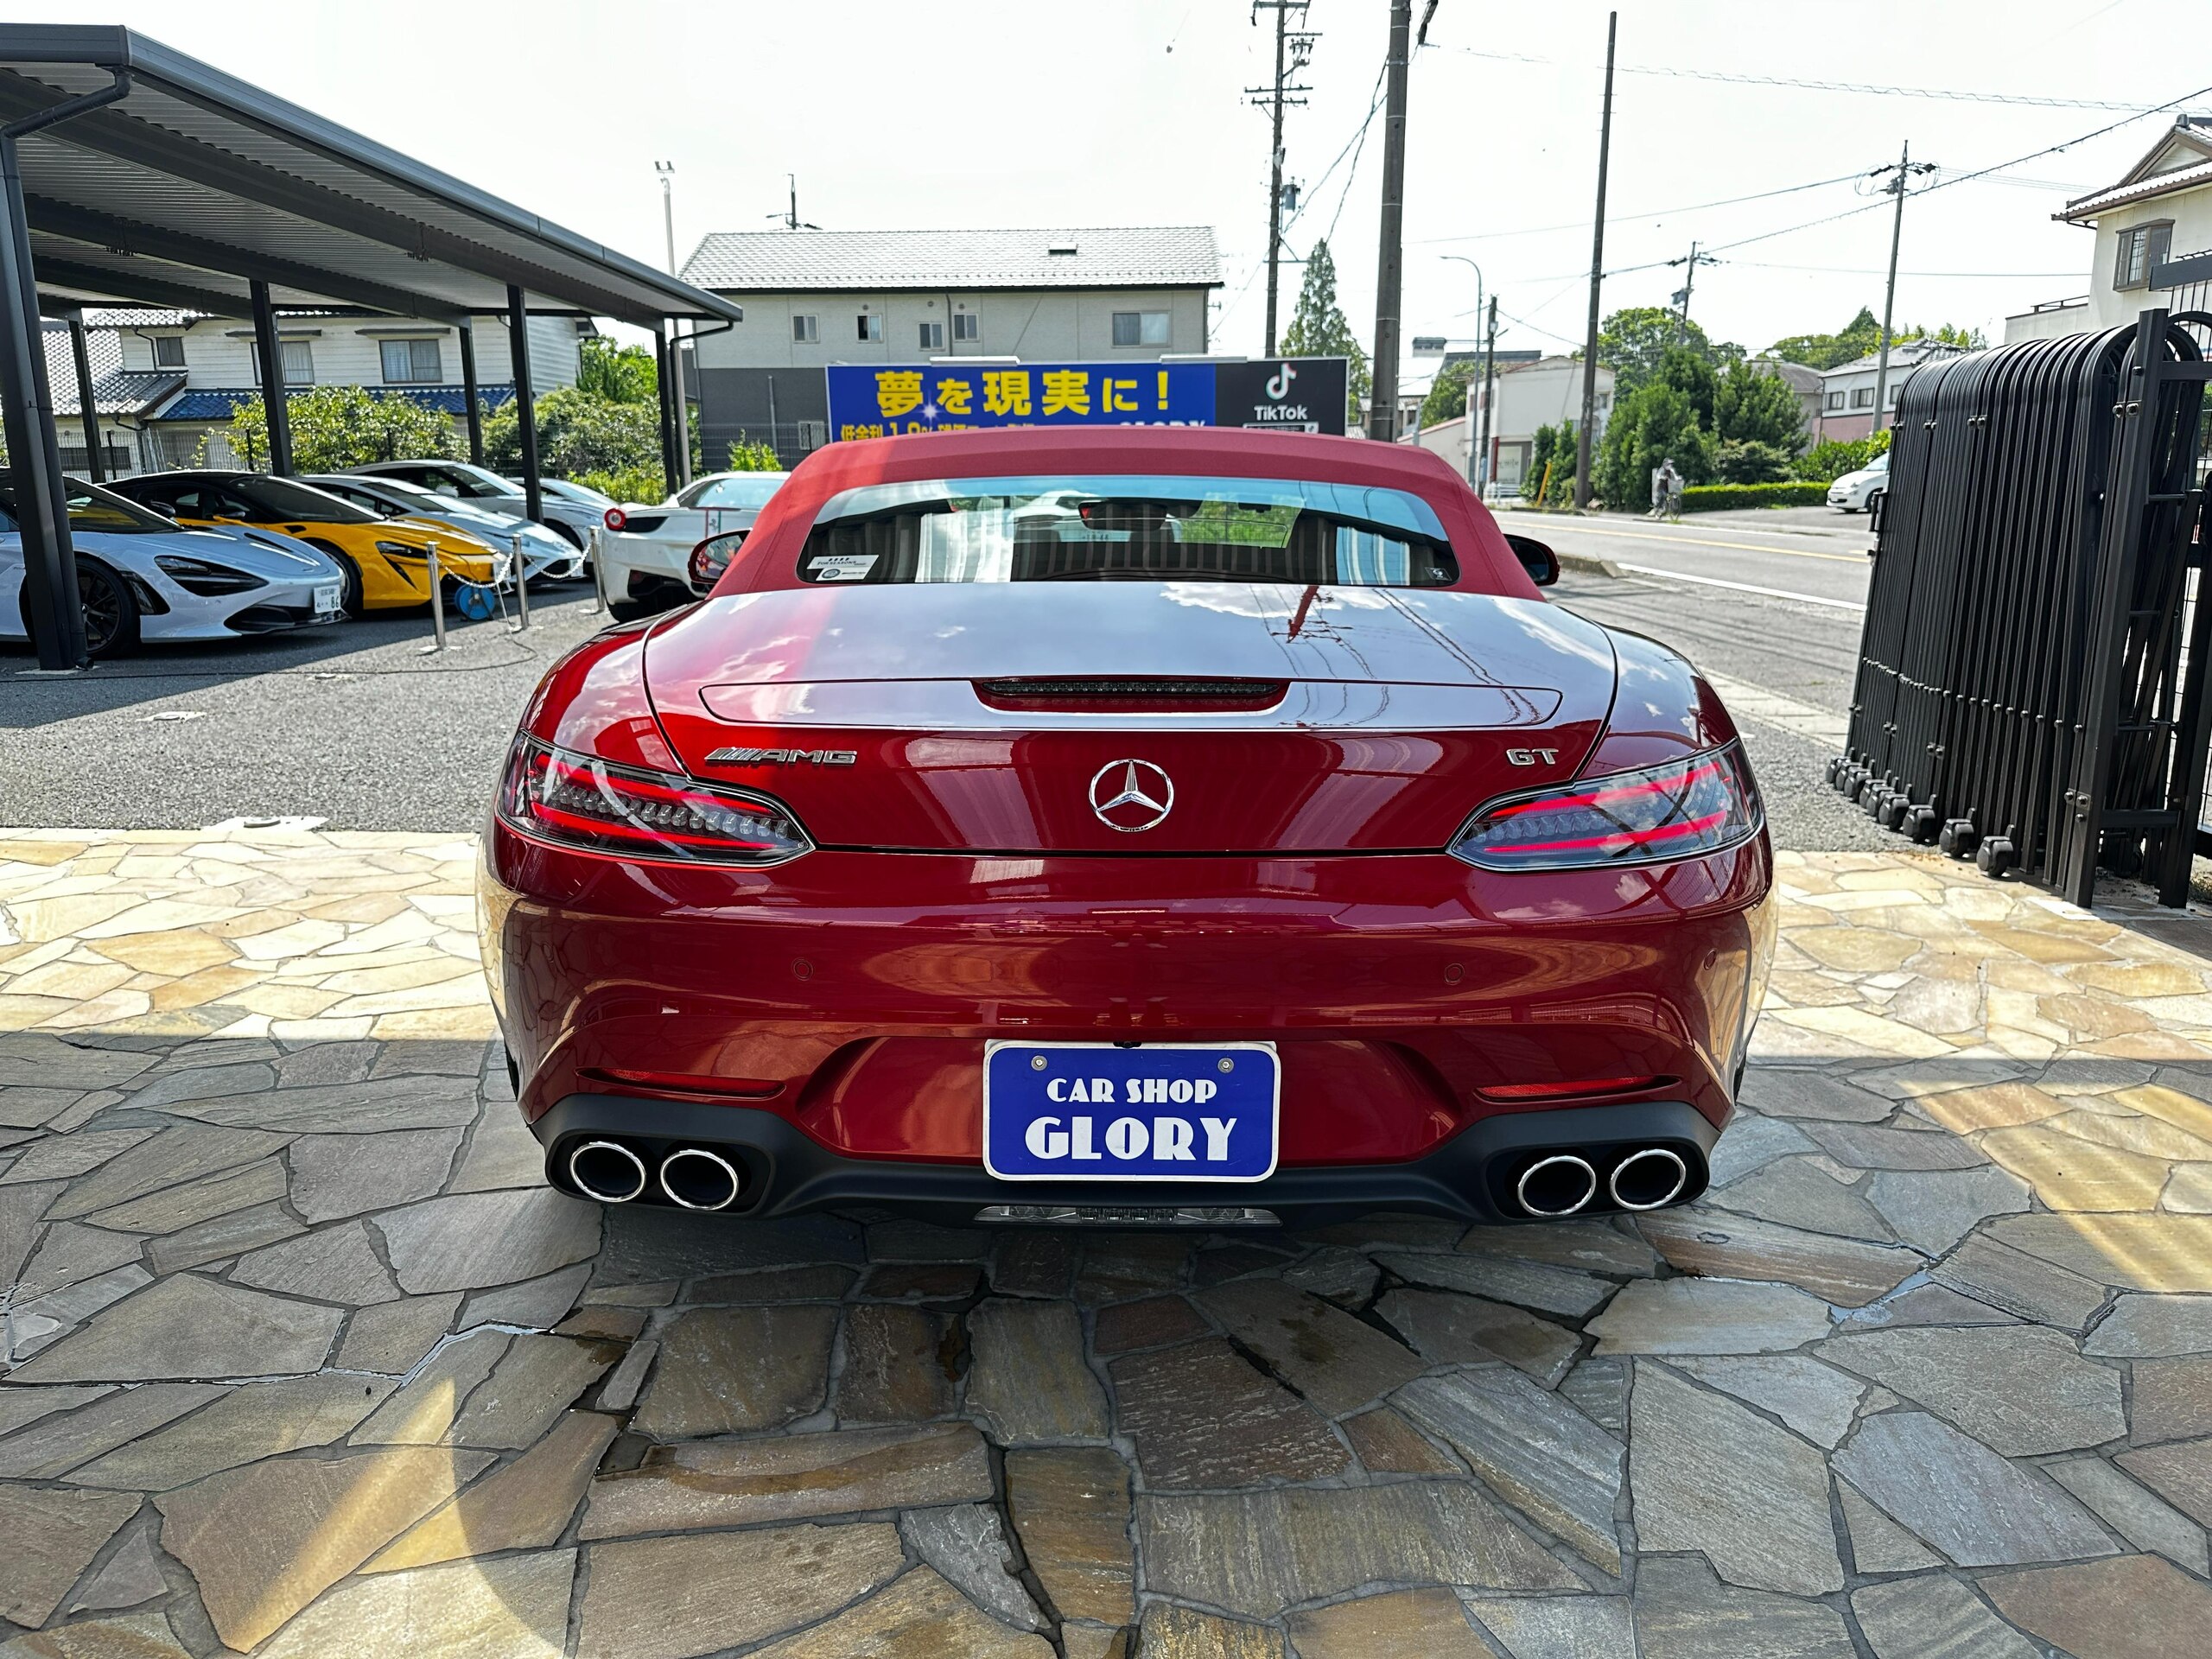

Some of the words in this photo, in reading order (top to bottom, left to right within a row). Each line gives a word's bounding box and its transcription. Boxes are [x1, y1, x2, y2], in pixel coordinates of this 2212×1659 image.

[1254, 404, 1307, 421] TikTok
[750, 748, 857, 764] AMG
[1506, 748, 1560, 766] GT
[1046, 1077, 1116, 1103] CAR
[1126, 1078, 1217, 1103] SHOP
[1025, 1116, 1237, 1160] GLORY
